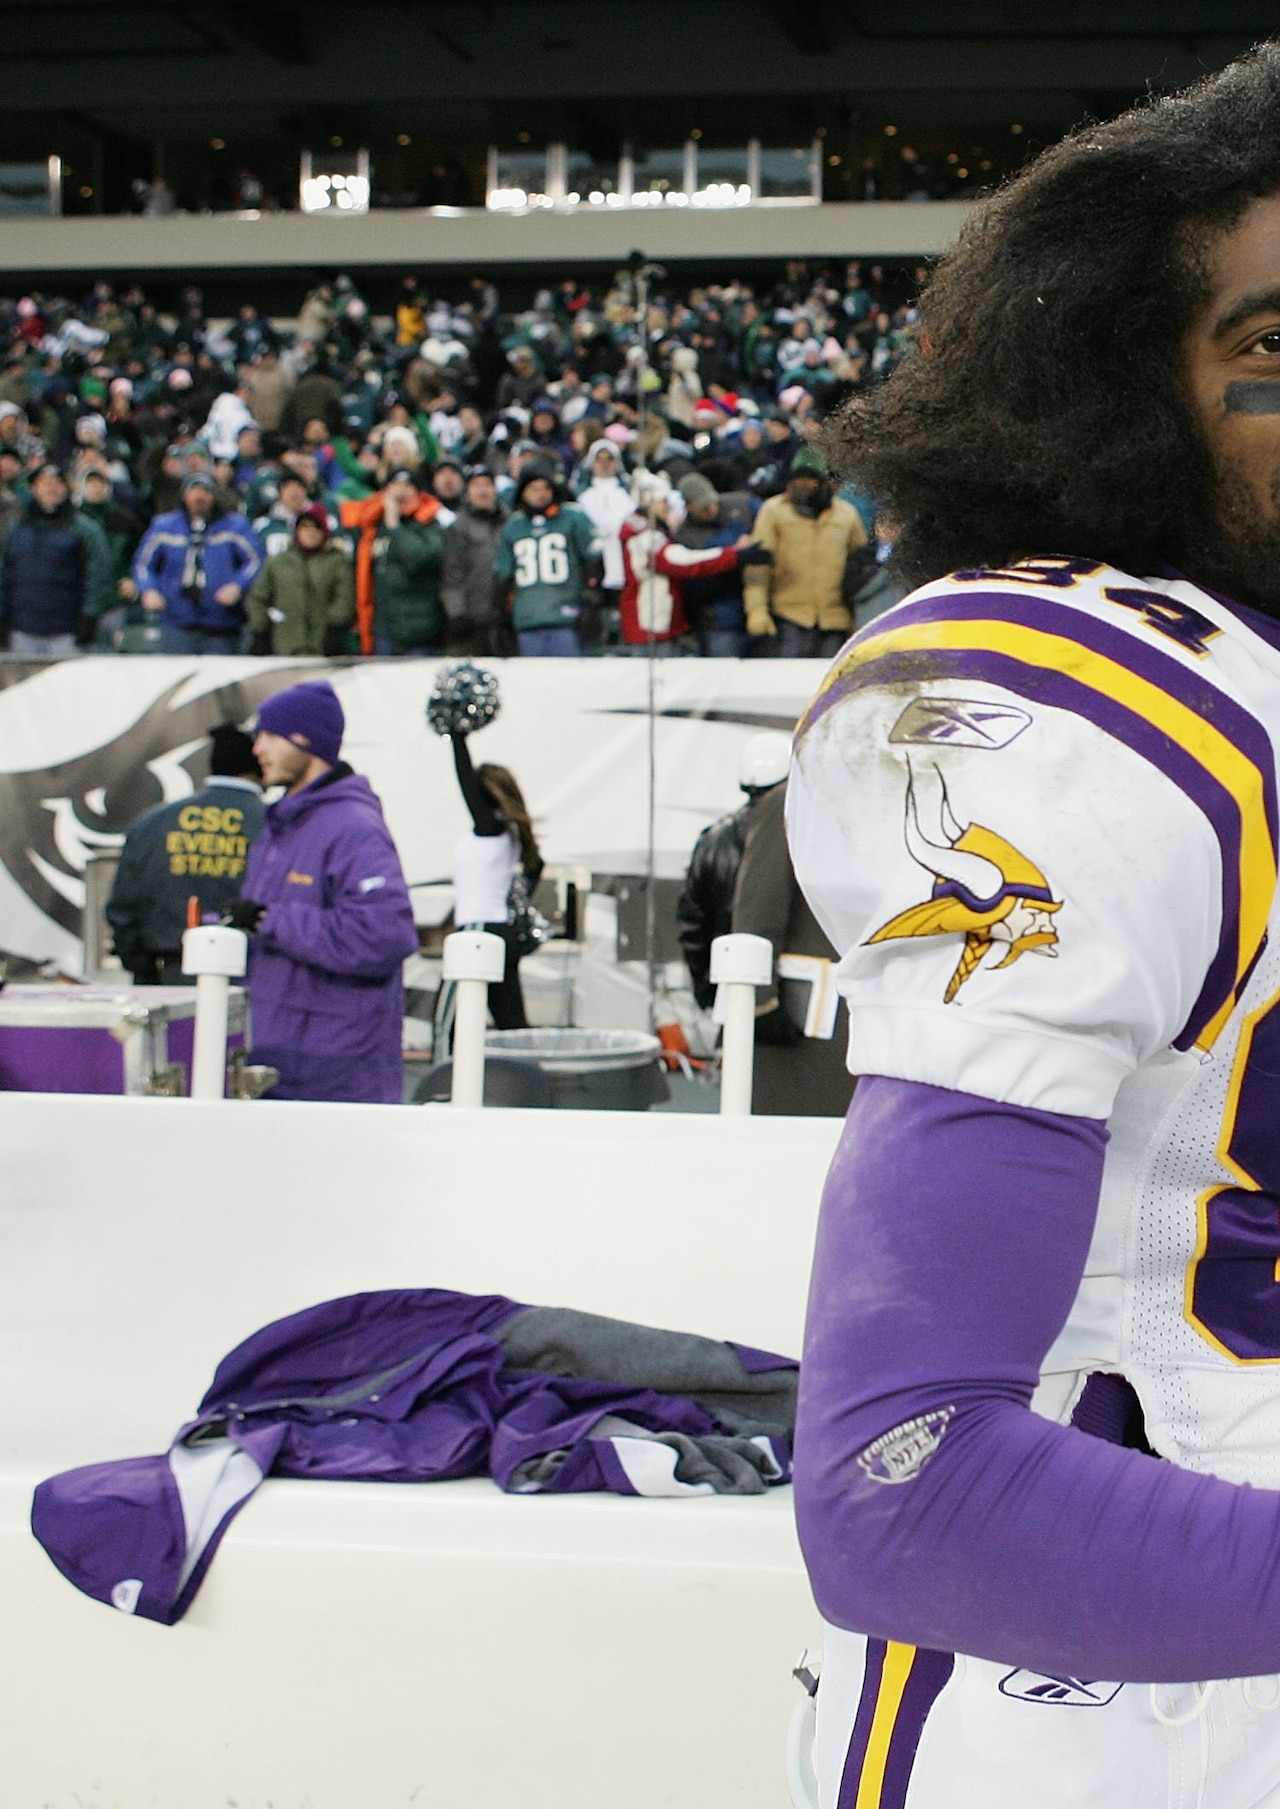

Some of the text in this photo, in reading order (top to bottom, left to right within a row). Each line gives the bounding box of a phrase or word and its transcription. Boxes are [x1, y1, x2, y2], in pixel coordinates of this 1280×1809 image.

[513, 532, 569, 588] 36
[178, 806, 244, 834] CSC
[166, 832, 247, 856] EVENT
[169, 854, 246, 878] STAFF
